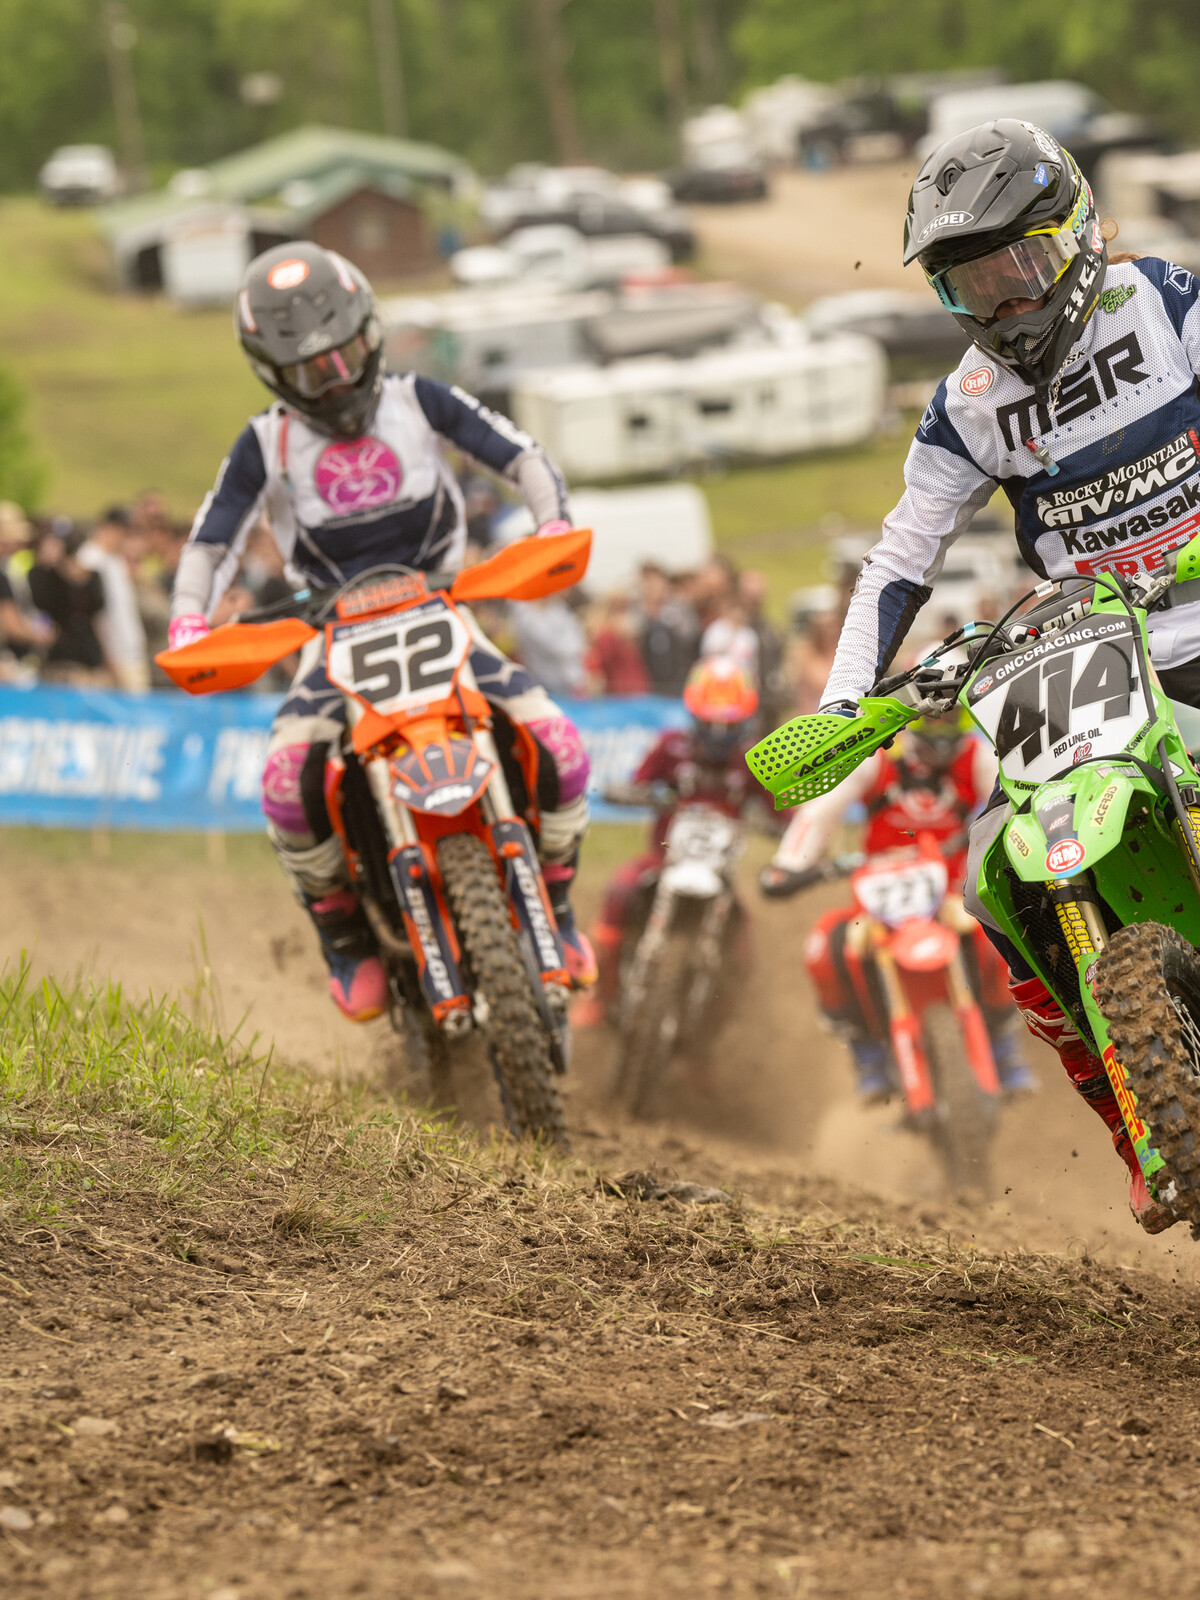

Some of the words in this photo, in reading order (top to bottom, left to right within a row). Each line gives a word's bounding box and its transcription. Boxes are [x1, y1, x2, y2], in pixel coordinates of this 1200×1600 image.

[922, 213, 964, 239] SHOEI
[1099, 284, 1124, 308] TEAM
[1105, 285, 1135, 313] GREEN
[996, 331, 1151, 451] MSR
[1053, 479, 1102, 506] ROCKY
[1108, 433, 1189, 489] MOUNTAIN
[350, 619, 453, 699] 52
[995, 621, 1127, 680] GNCCRACING.COM
[996, 641, 1138, 768] 414
[800, 727, 875, 777] ACERBIS
[1053, 742, 1068, 758] RED
[1068, 733, 1087, 748] LINE
[1087, 728, 1102, 740] OIL
[1124, 719, 1153, 753] Kawasa
[1014, 780, 1040, 792] Kawas
[1094, 786, 1118, 826] ACERBIS
[1008, 830, 1030, 857] ACERBIS
